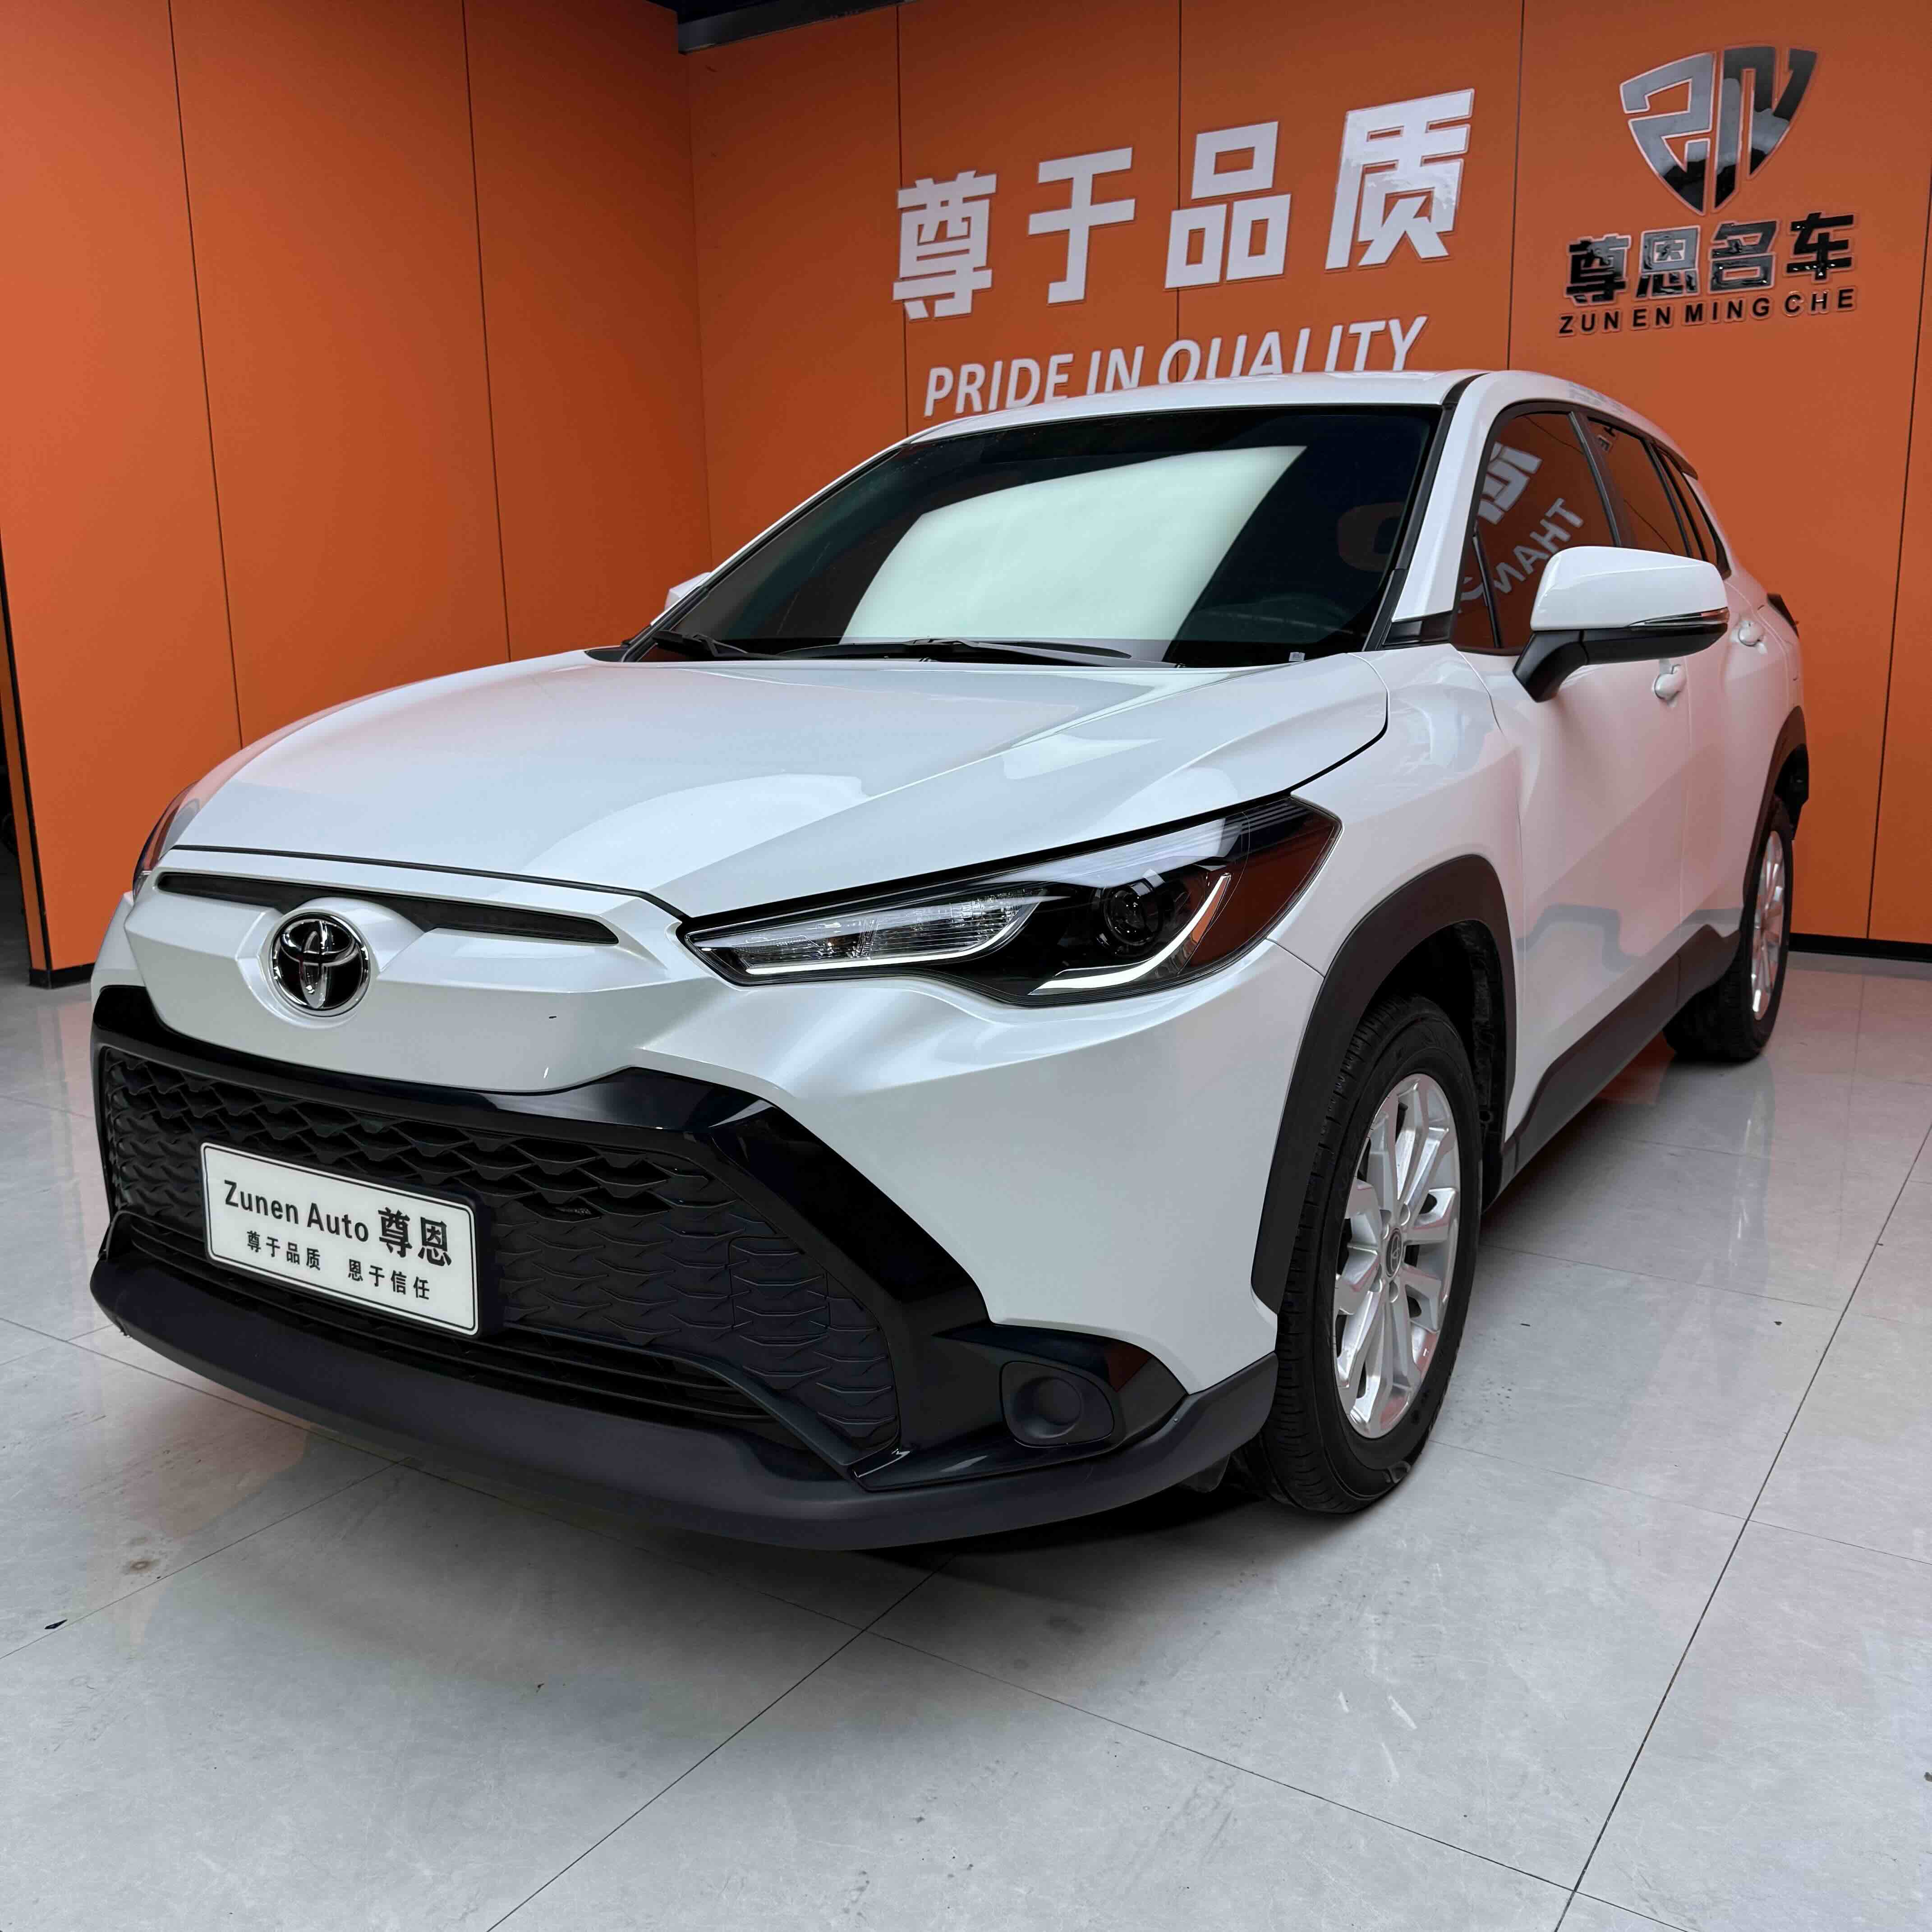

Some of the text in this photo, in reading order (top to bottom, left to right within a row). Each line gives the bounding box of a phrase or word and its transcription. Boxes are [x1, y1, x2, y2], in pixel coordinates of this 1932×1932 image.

[893, 88, 1474, 320] 尊于品质
[1565, 211, 1854, 304] 尊恩名车
[924, 353, 1074, 417] PRIDE
[1086, 346, 1145, 395] IN
[224, 1179, 452, 1266] Zunen Auto 尊恩
[246, 1230, 430, 1300] 尊于品质 恩于信任
